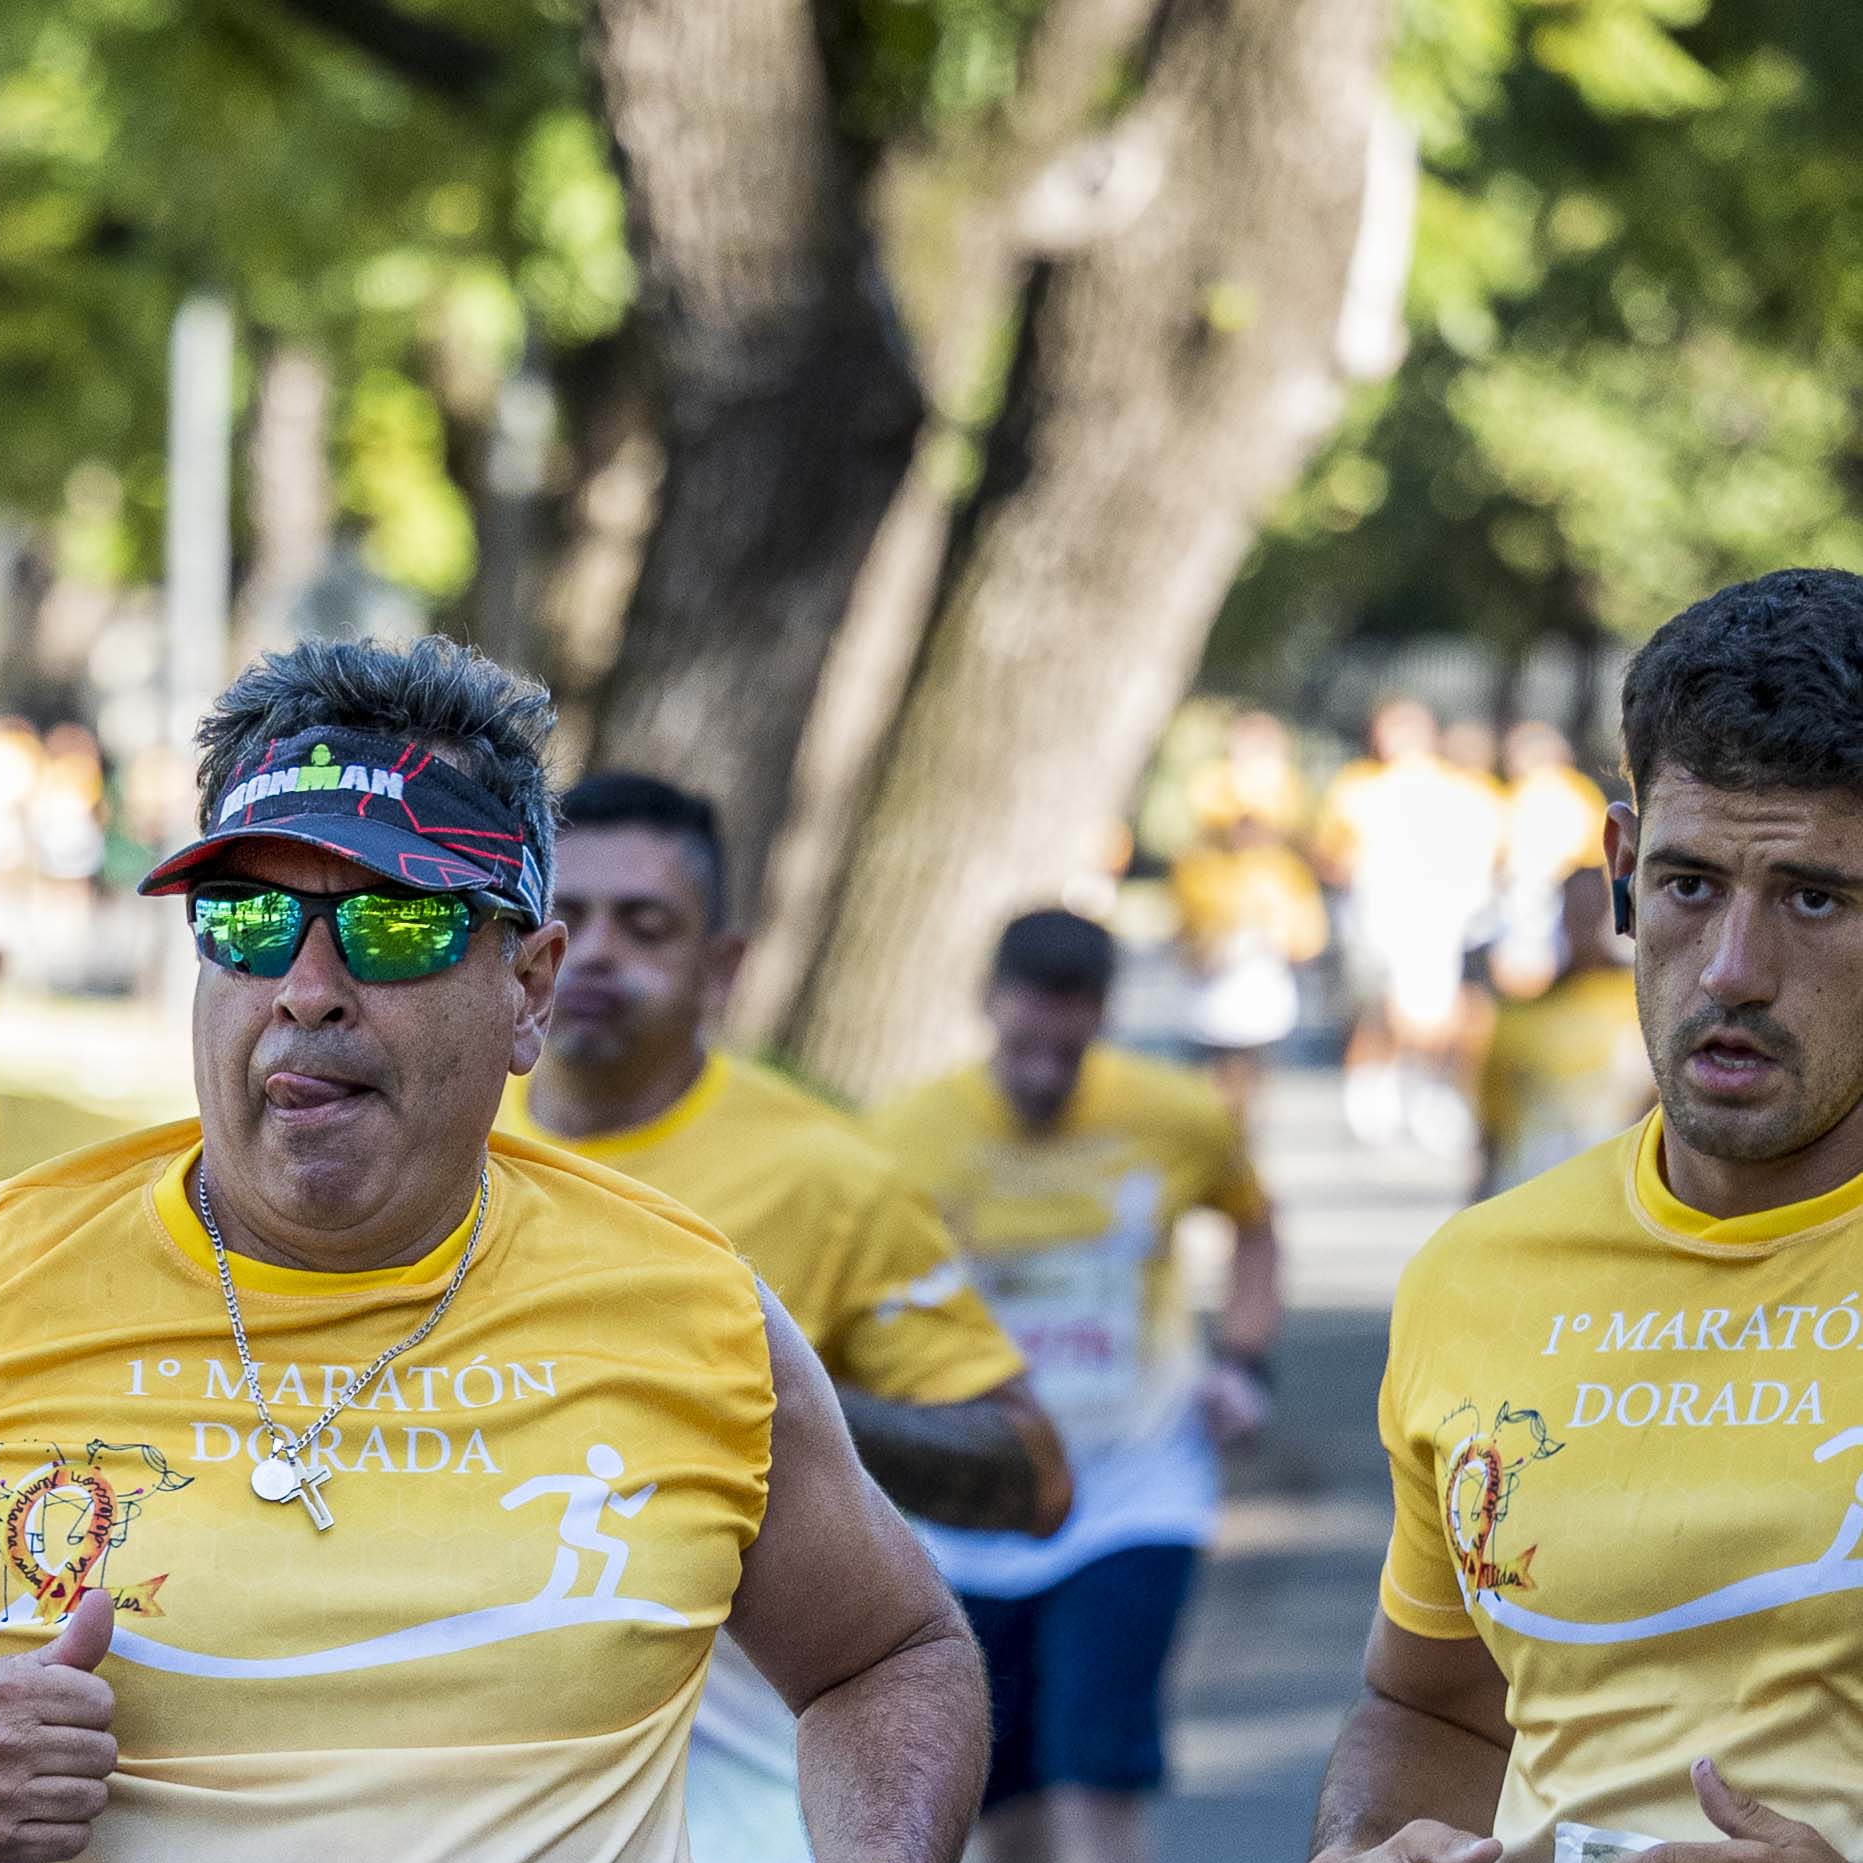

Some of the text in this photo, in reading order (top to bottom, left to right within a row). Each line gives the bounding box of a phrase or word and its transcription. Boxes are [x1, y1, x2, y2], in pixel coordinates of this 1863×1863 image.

[1595, 1292, 1863, 1353] MARATÓ
[203, 1354, 557, 1412] MARATÓN
[1565, 1381, 1825, 1428] DORADA
[190, 1421, 503, 1474] DORADA
